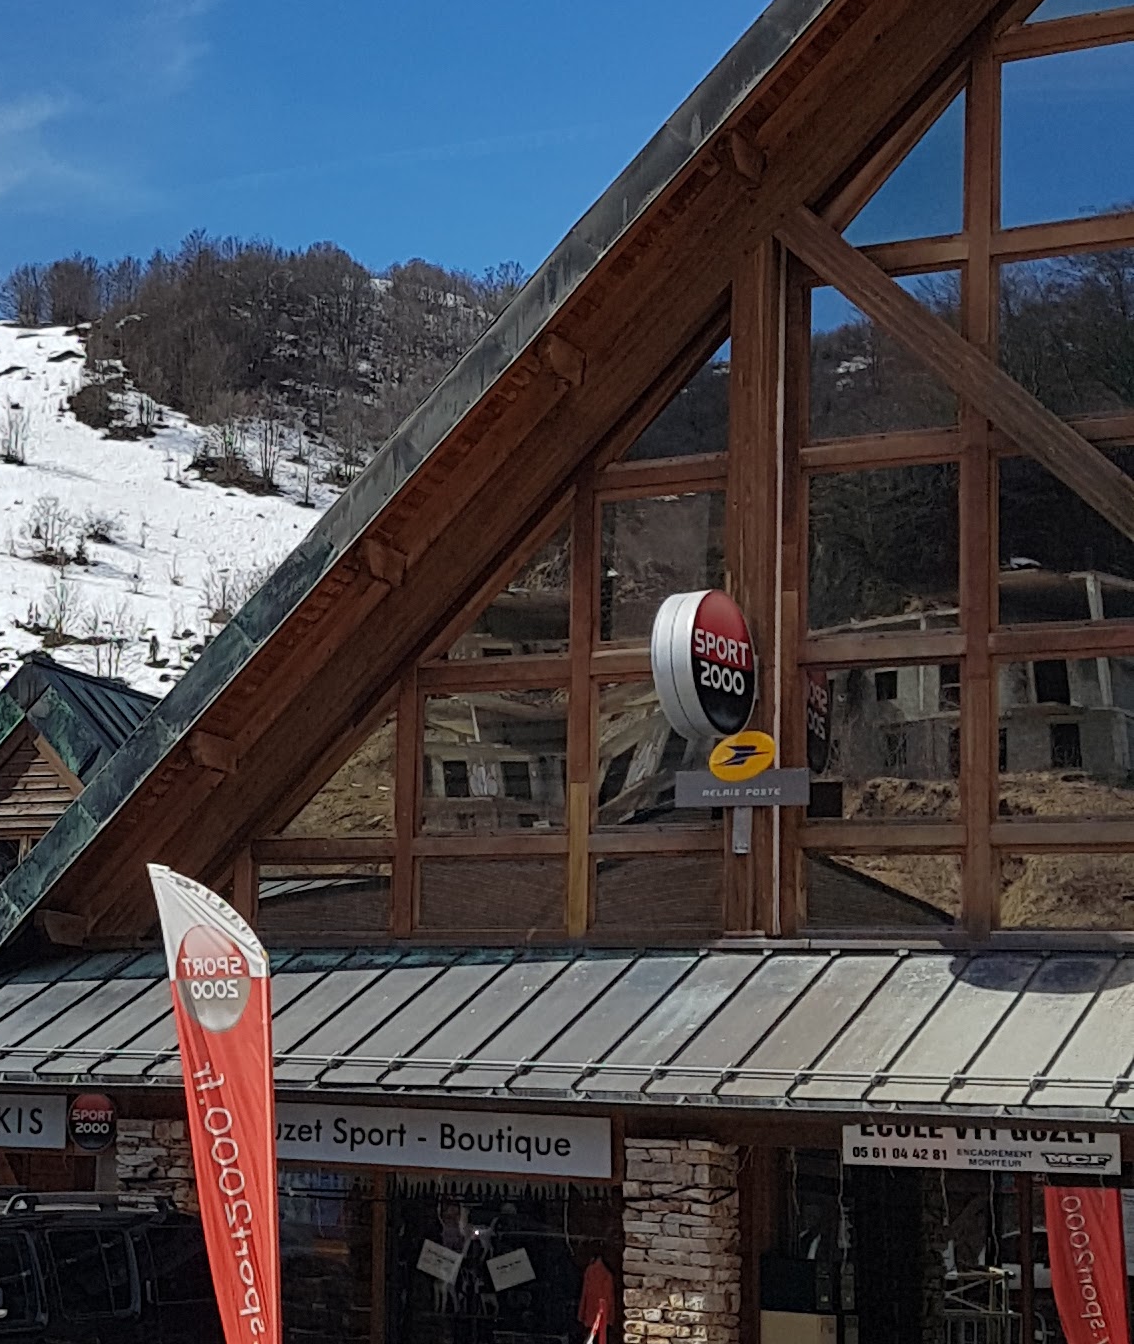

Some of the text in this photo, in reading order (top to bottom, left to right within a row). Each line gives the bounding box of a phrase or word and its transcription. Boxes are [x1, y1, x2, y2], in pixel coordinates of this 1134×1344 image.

[694, 628, 749, 667] SPORT
[700, 660, 745, 696] 2000
[71, 1108, 115, 1122] SPORT
[75, 1122, 110, 1135] 2000
[333, 1117, 407, 1152] Sport
[440, 1123, 572, 1162] Boutique
[852, 1146, 868, 1158] 05
[912, 1148, 929, 1161] 42
[932, 1149, 947, 1161] 81
[956, 1148, 1033, 1159] ENCADREMENT
[968, 1158, 1022, 1168] MONITEUR
